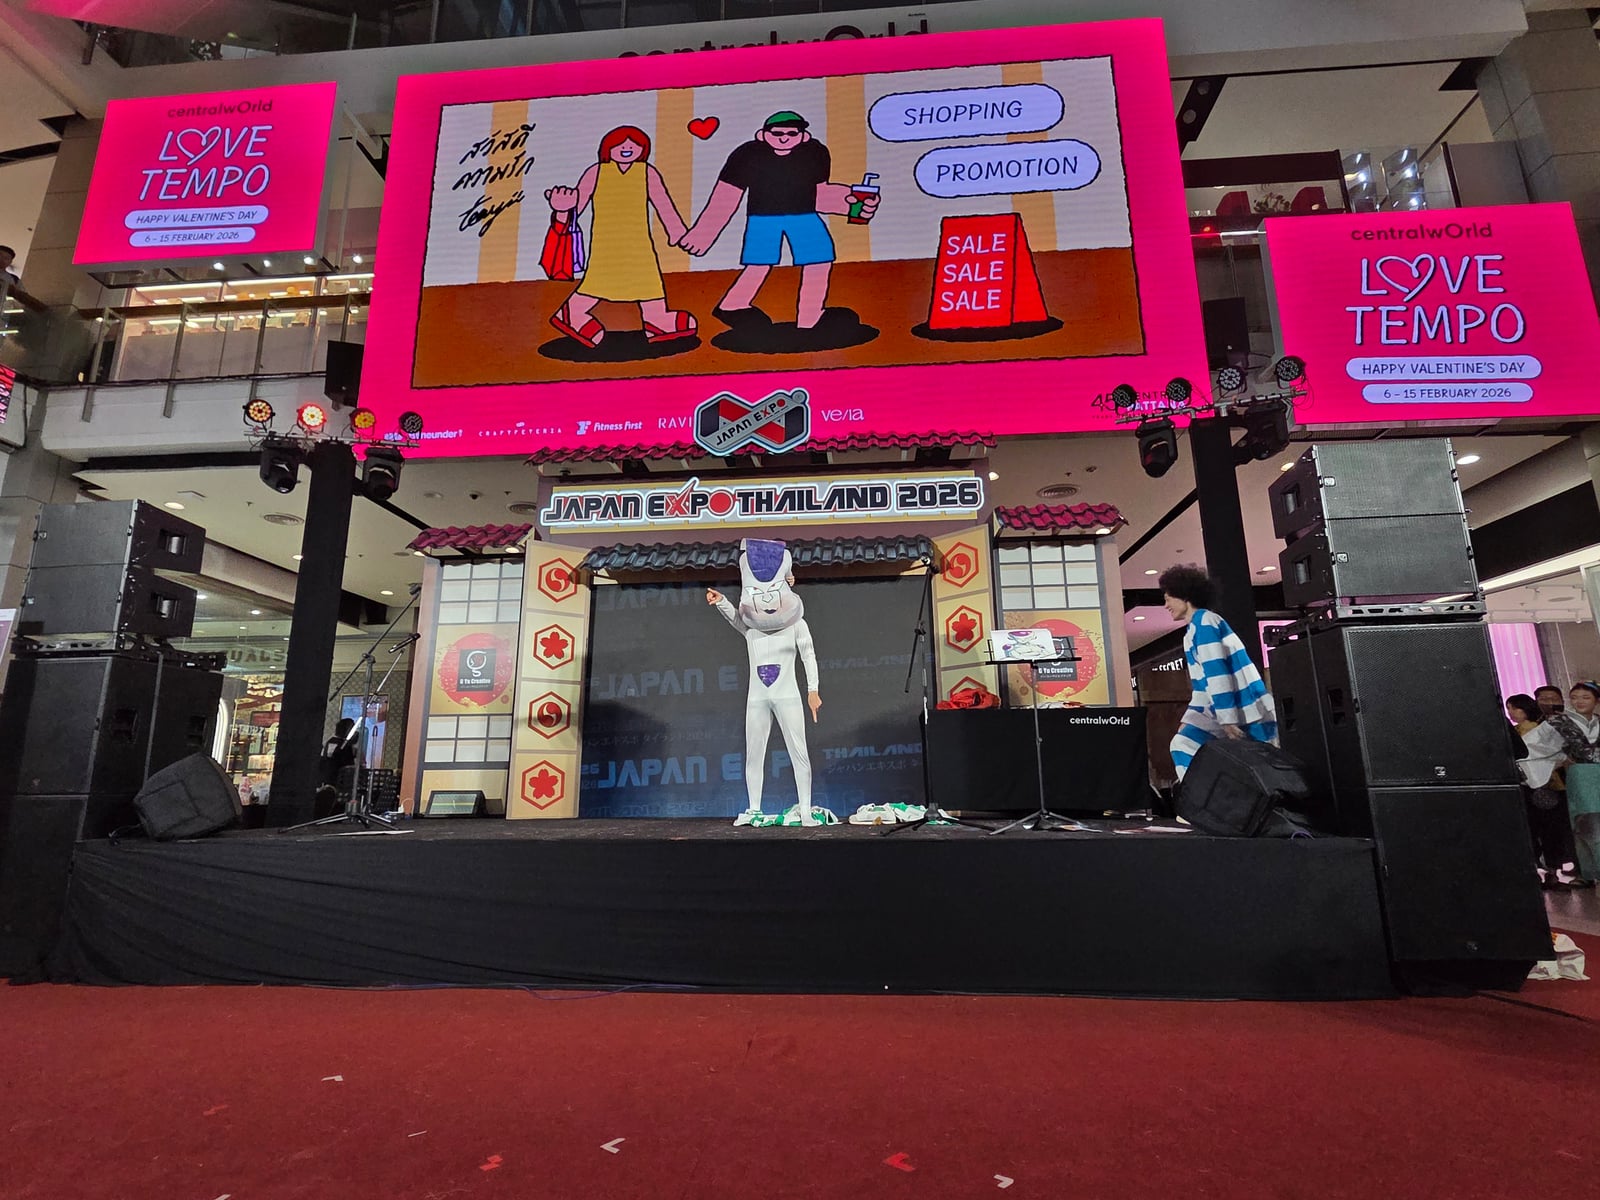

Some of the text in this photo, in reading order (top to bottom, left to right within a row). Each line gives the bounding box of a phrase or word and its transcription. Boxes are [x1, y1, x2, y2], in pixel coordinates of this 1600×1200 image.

[168, 100, 272, 117] centralwOrld
[903, 100, 1023, 126] SHOPPING
[936, 156, 1079, 183] PROMOTION
[139, 164, 271, 201] TEMPO
[136, 214, 169, 224] HAPPY
[237, 210, 258, 220] DAY
[171, 233, 214, 242] FEBRUARY
[217, 231, 239, 240] 2026
[1351, 223, 1492, 241] centralwOrld
[946, 233, 1007, 256] SALE
[943, 260, 1004, 283] SALE
[940, 288, 1001, 312] SALE
[1345, 303, 1526, 346] TEMPO
[1362, 362, 1526, 375] HAPPY VALENTINE'S DAY
[1384, 390, 1391, 398] 6
[1404, 389, 1416, 398] 15
[1420, 388, 1477, 398] FEBRUARY
[1481, 388, 1511, 397] 2026
[658, 416, 693, 429] RAVI
[716, 398, 786, 445] JAPAN EXPO
[545, 479, 979, 521] JAPAN EXPO THAILAND 2026
[230, 648, 285, 663] UALS
[598, 667, 704, 699] JAPAN
[1070, 716, 1130, 725] centralwOrld
[597, 755, 707, 789] JAPAN
